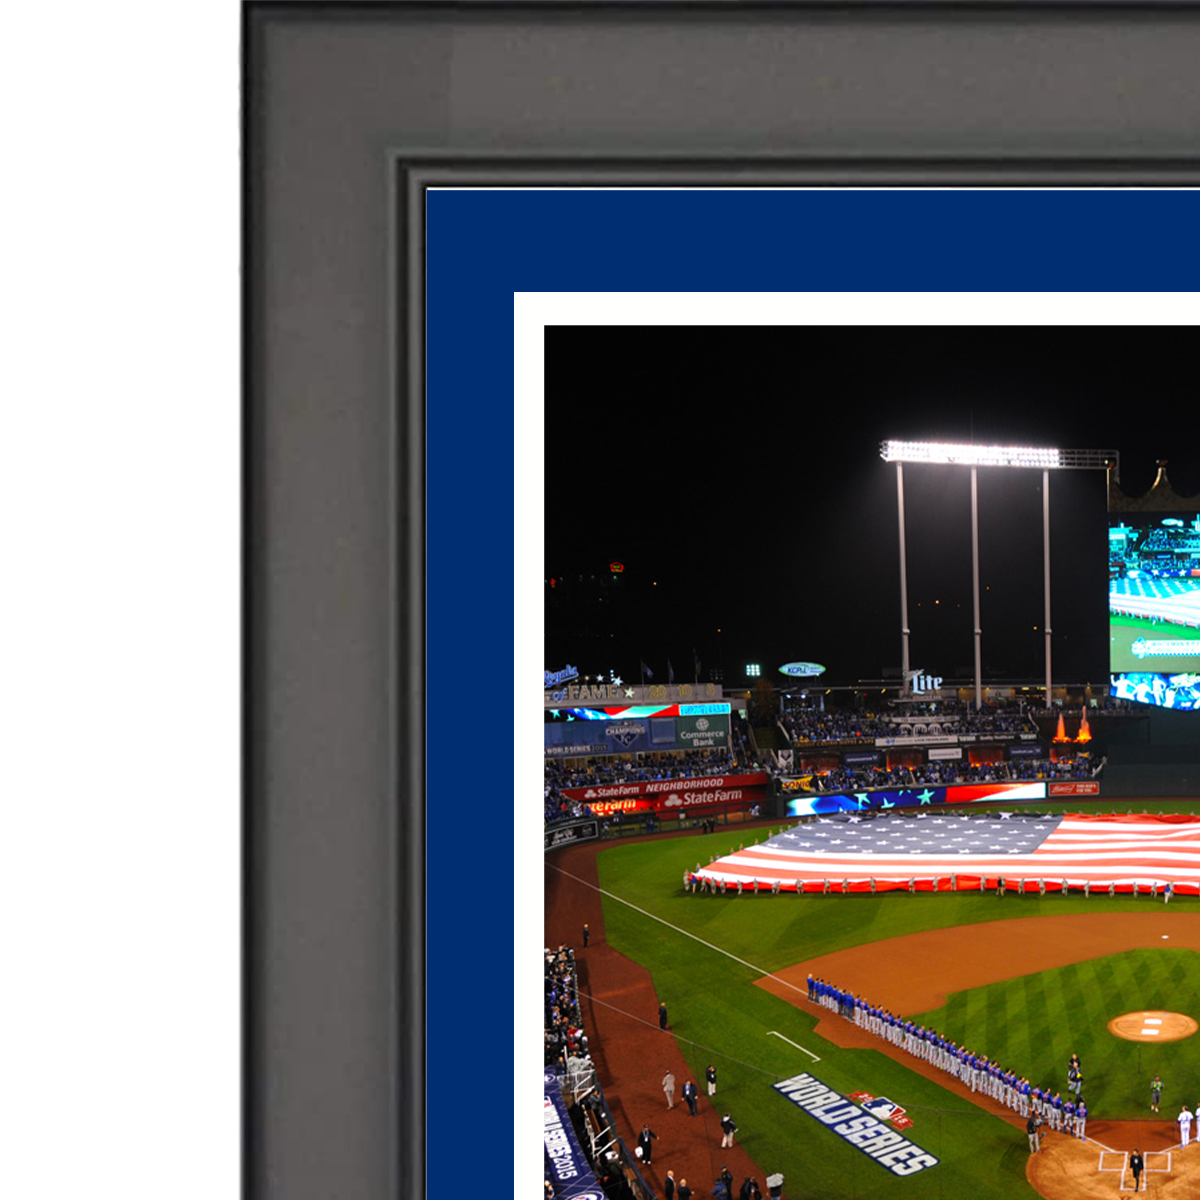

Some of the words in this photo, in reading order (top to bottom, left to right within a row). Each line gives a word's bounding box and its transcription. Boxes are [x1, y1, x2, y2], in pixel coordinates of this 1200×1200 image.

[568, 684, 620, 700] FAME
[649, 685, 666, 699] 20
[677, 684, 691, 697] 10
[706, 683, 715, 696] 5
[912, 674, 944, 696] Lite
[605, 727, 646, 737] CHAMPIONS
[681, 731, 725, 739] Commerce
[693, 738, 715, 747] Bank
[646, 778, 724, 793] NEIGHBORHOOD
[773, 1072, 864, 1125] WORLD
[833, 1115, 940, 1177] SERIES
[553, 1155, 579, 1181] 2015
